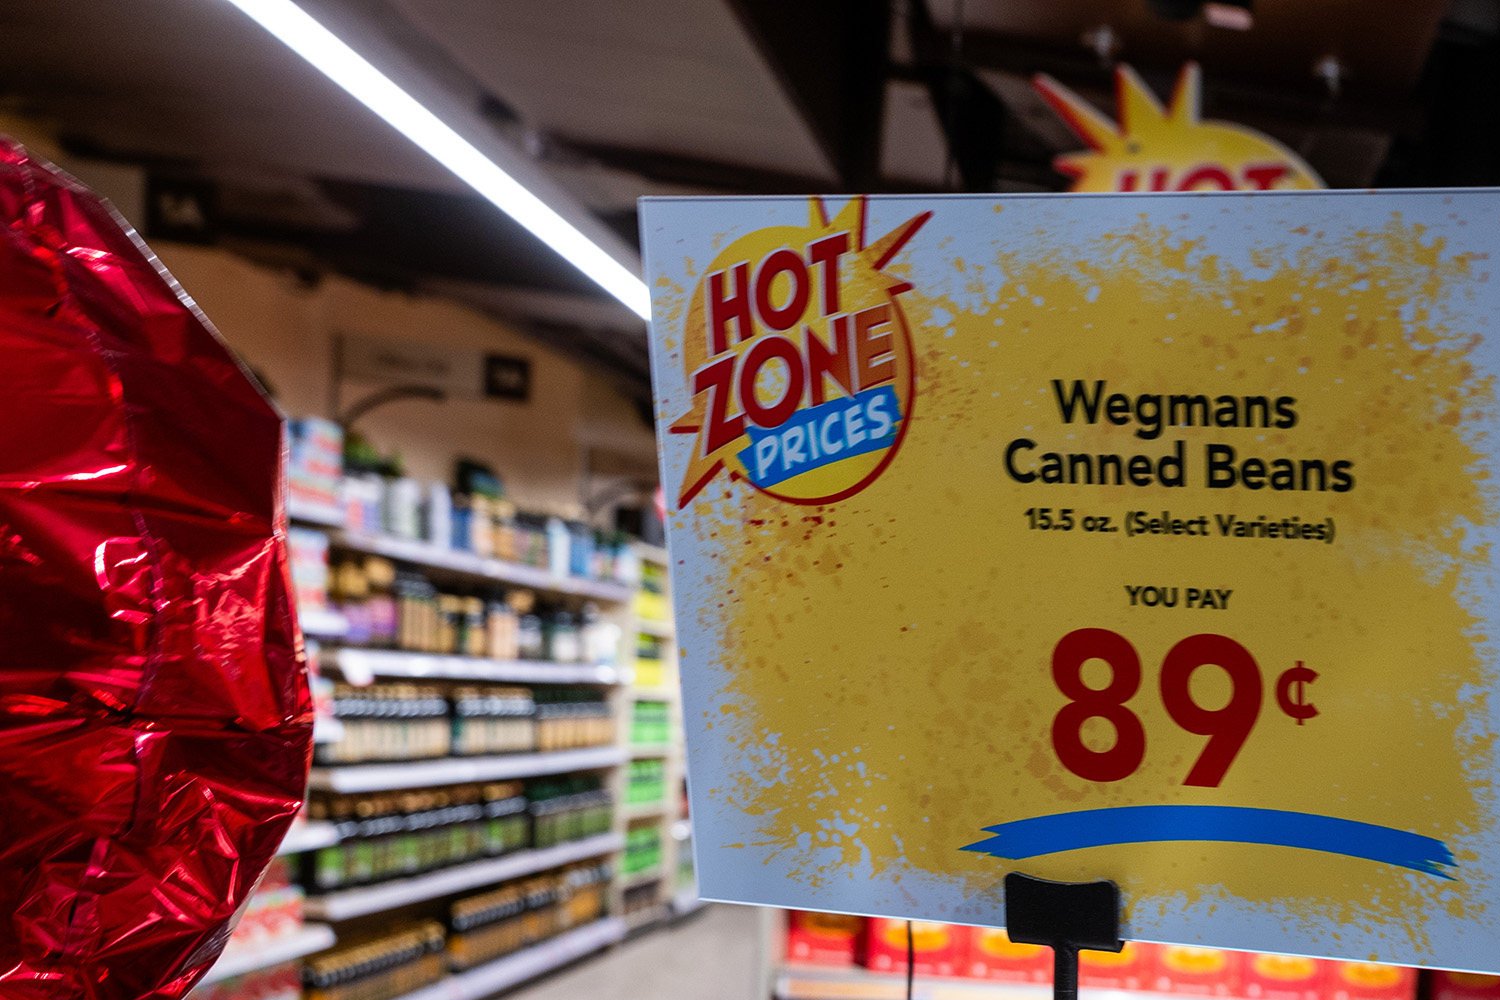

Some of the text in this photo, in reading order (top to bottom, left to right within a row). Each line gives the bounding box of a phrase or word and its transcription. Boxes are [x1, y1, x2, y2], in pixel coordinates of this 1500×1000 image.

[706, 230, 850, 357] HOT
[690, 302, 897, 460] ZONE
[1051, 379, 1298, 440] Wegmans
[754, 394, 890, 480] PRICES
[1005, 437, 1355, 492] Canned Beans
[1024, 508, 1336, 544] 15.5 oz. (Select Varieties)
[1125, 586, 1233, 609] YOU PAY
